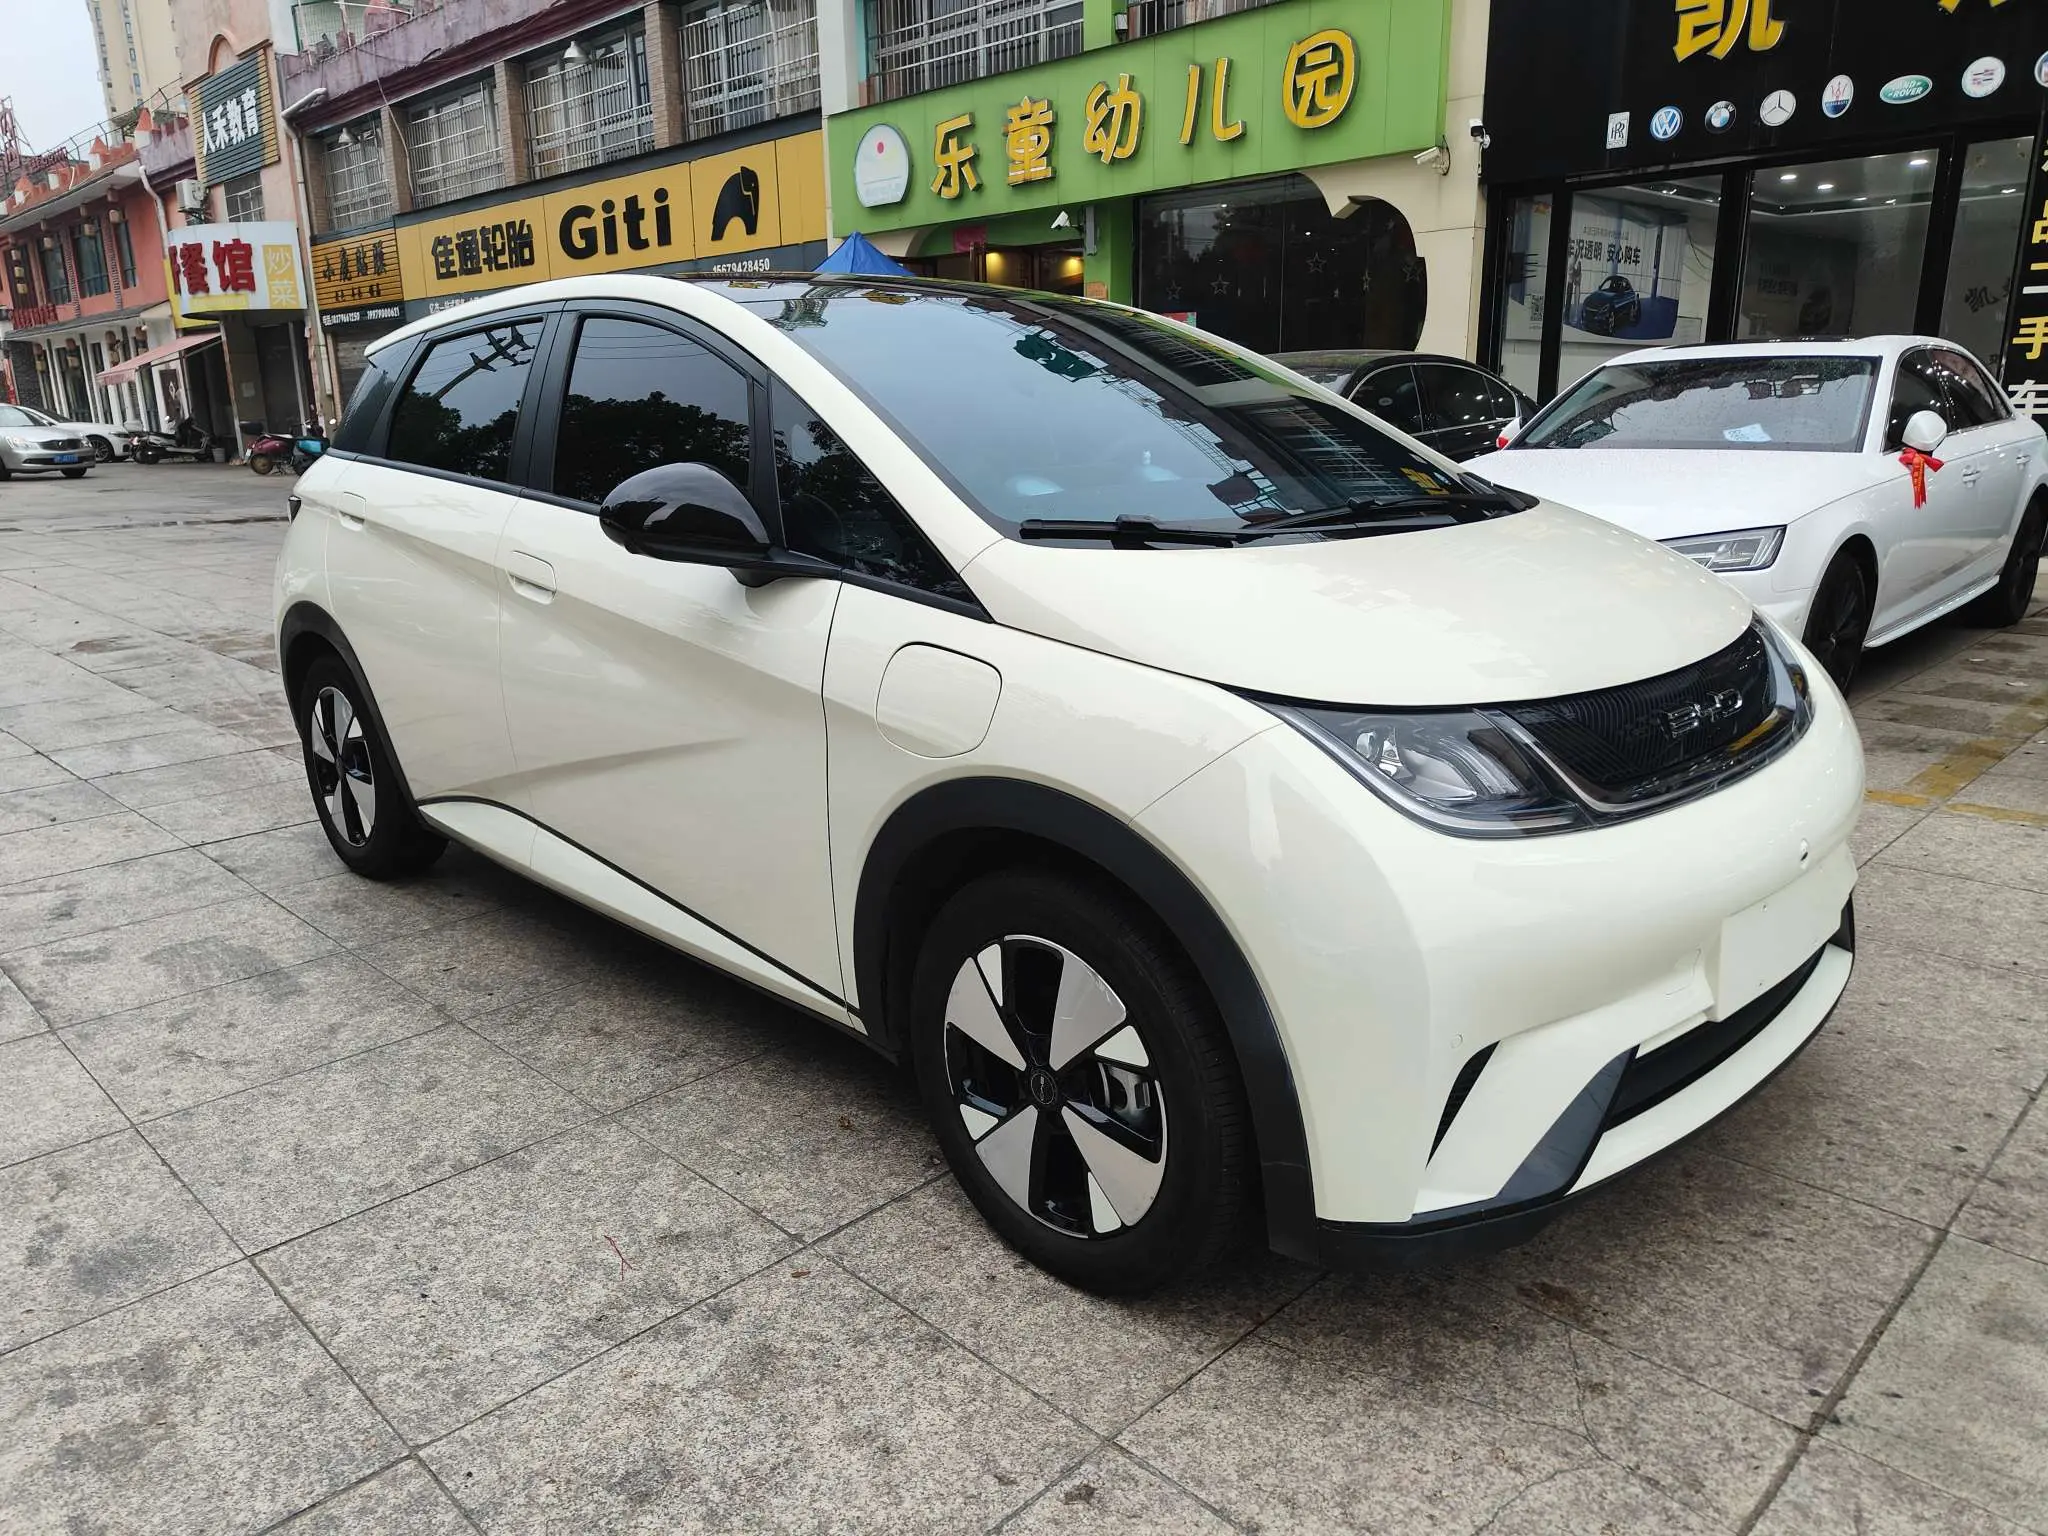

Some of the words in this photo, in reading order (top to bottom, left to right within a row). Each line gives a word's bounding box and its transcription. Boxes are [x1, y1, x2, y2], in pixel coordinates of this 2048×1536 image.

[201, 87, 259, 156] 人禾教育
[930, 29, 1360, 200] 乐童幼儿园
[431, 218, 535, 280] 佳通轮胎
[559, 187, 672, 260] Giti
[267, 247, 298, 306] 炒菜
[1667, 688, 1743, 739] BYD
